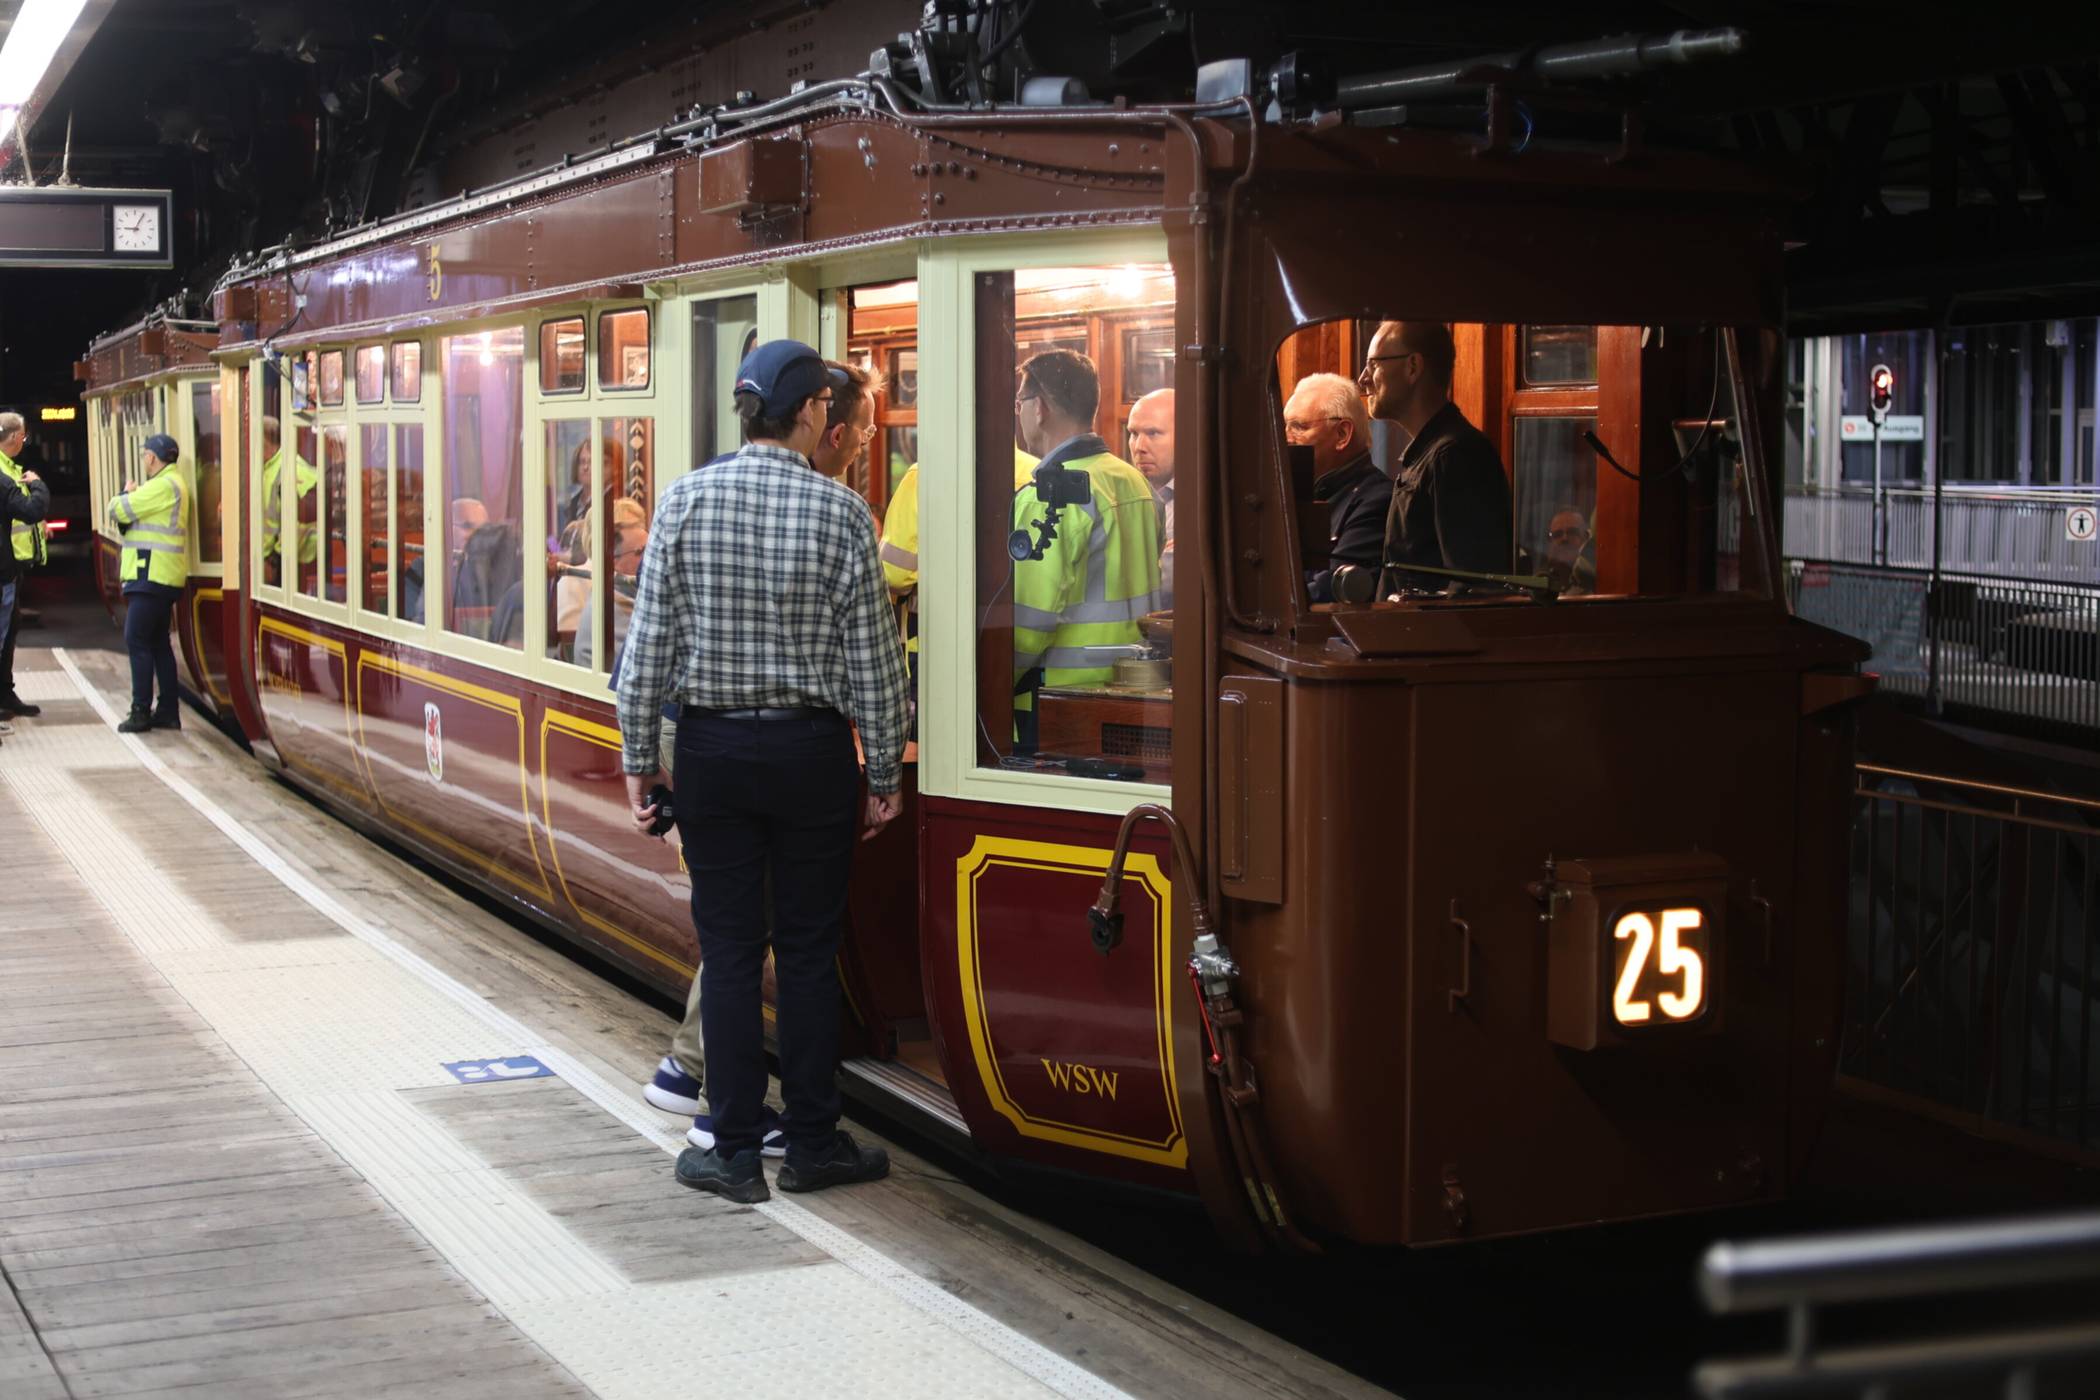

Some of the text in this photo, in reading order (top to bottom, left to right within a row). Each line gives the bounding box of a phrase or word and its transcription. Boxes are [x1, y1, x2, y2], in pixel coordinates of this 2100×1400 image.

[431, 244, 441, 301] 5
[1613, 908, 1703, 1021] 25
[1040, 1057, 1118, 1101] WSW
